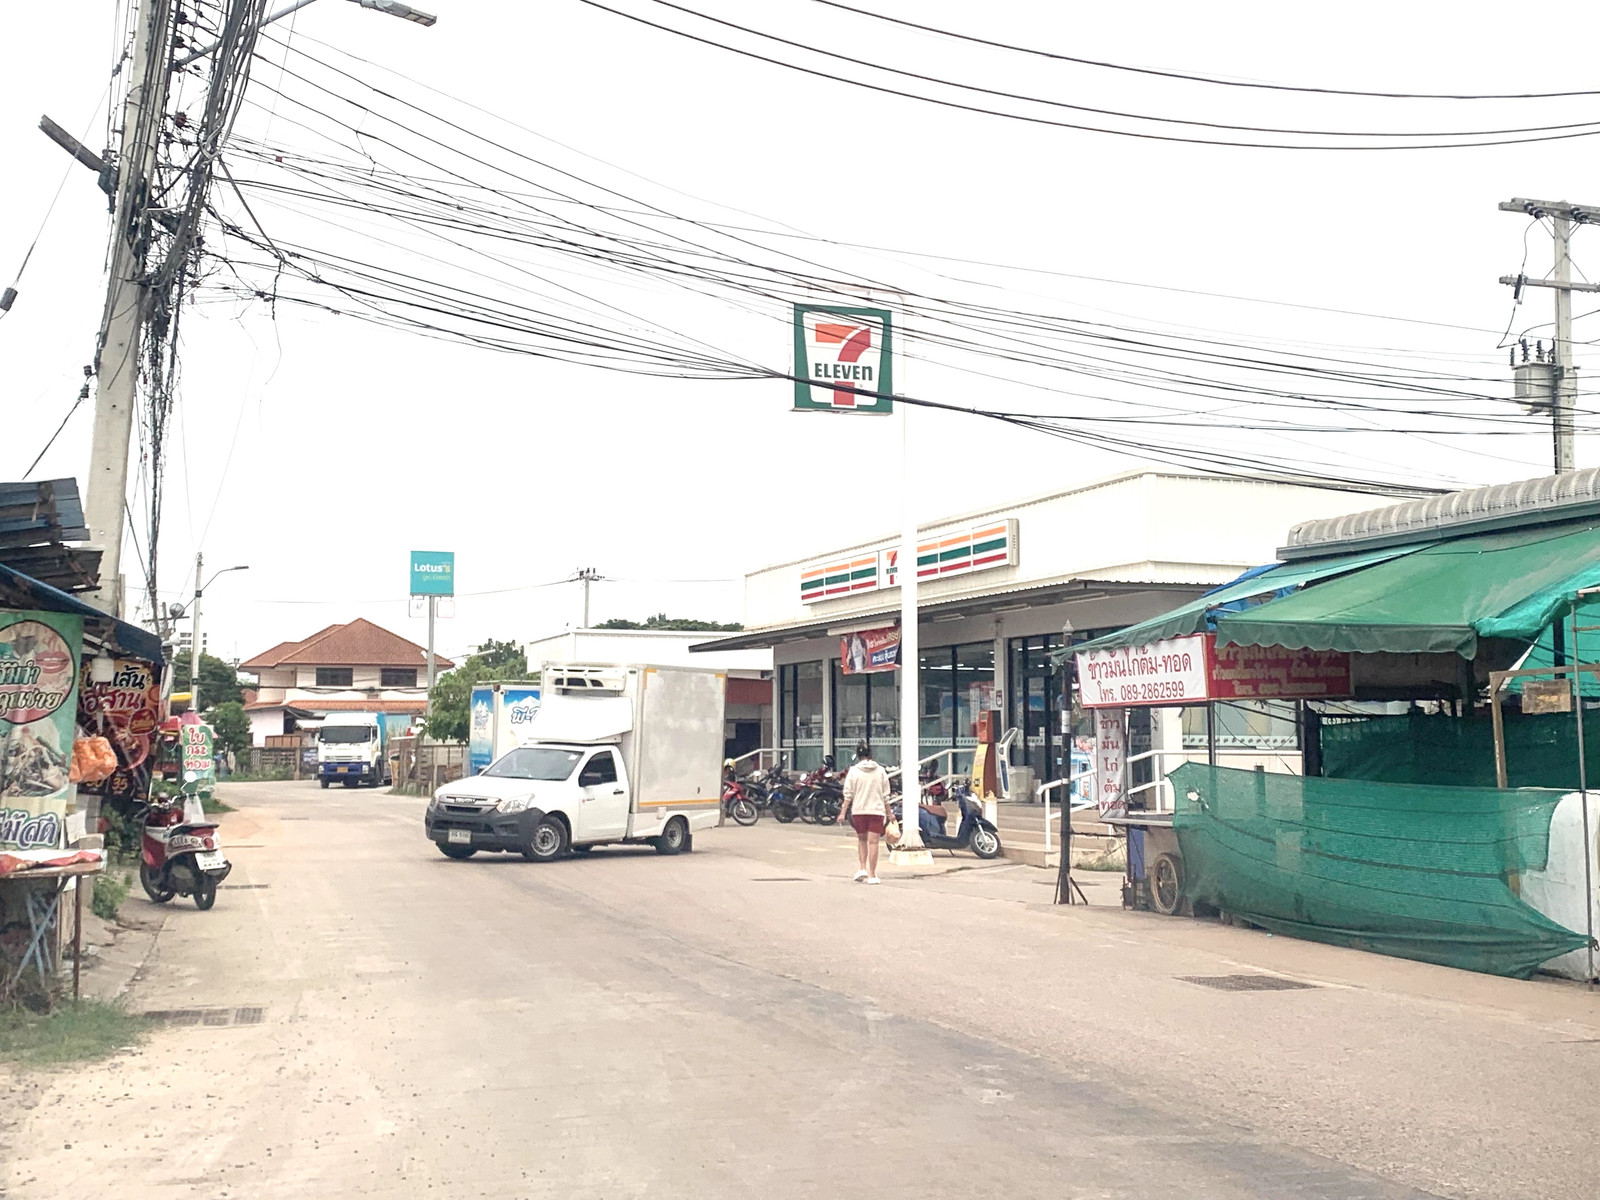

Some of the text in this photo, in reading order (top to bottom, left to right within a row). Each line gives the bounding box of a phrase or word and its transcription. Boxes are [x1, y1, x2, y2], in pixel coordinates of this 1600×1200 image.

[815, 323, 870, 405] 7
[1097, 680, 1185, 702] โทร. 089-2862599
[1100, 714, 1120, 729] ข้าว
[189, 727, 205, 743] ใบ
[186, 745, 207, 755] กระ
[1101, 736, 1120, 750] มัน
[184, 755, 210, 769] ท่อม
[1103, 757, 1118, 772] ไก่
[112, 777, 128, 791] 35
[1103, 778, 1121, 793] ต้ม
